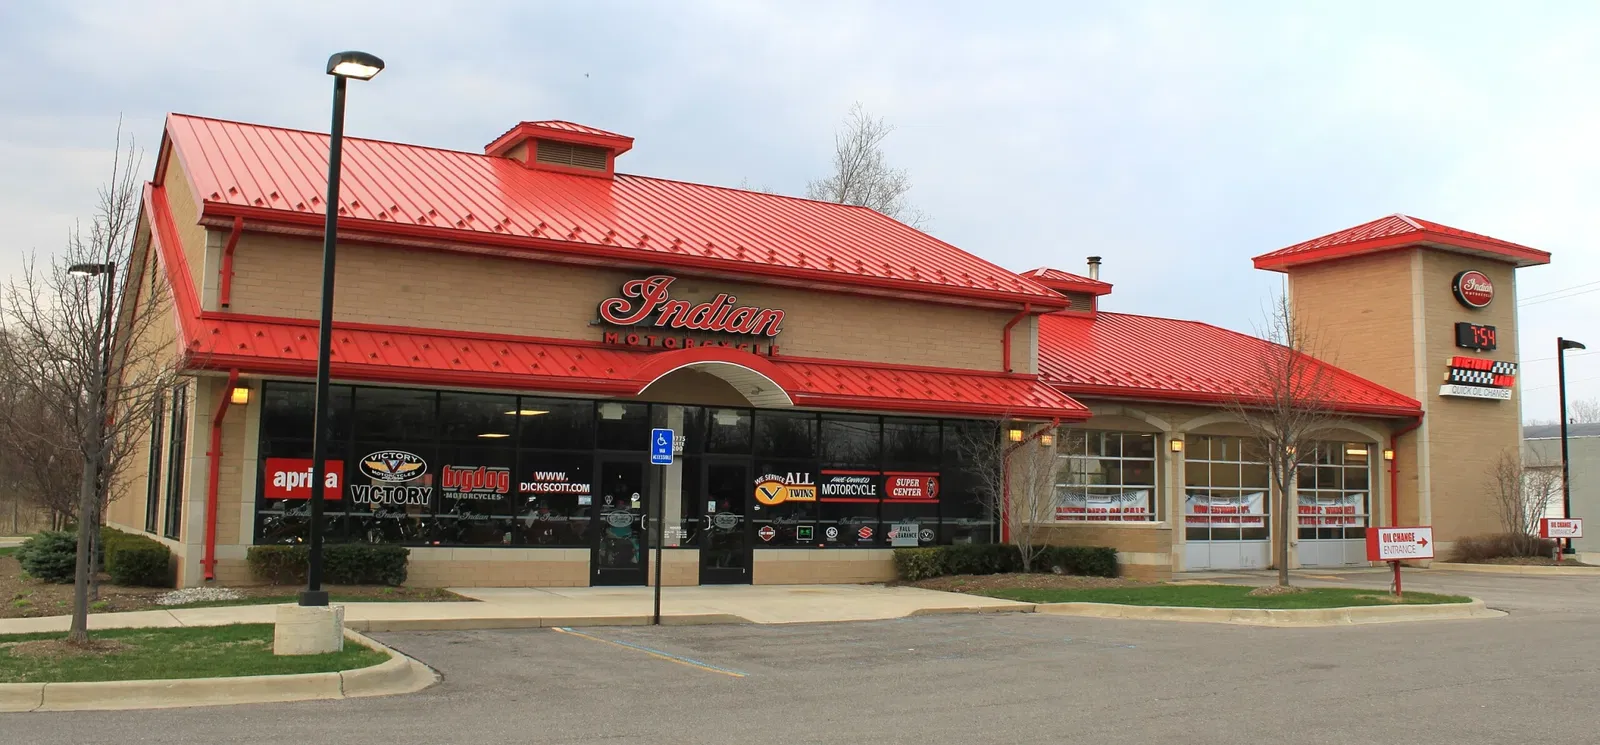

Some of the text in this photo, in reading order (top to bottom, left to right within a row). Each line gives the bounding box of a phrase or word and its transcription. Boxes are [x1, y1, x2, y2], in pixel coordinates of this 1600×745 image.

[600, 275, 785, 337] Indian
[1471, 326, 1495, 346] 7:54
[1452, 356, 1494, 370] VICTORY
[1452, 385, 1472, 397] QUICK
[1483, 388, 1509, 399] CHANGE
[371, 452, 418, 463] VICTORY
[273, 467, 337, 491] apria
[534, 471, 569, 481] WWW.
[764, 473, 786, 484] SERVICE
[784, 471, 815, 485] ALL
[519, 482, 591, 493] DICKSCOTT.COM
[895, 478, 920, 487] SUPER
[350, 484, 433, 505] VICTORY
[788, 489, 814, 498] TWINS
[821, 483, 876, 496] MOTORCYCLE
[893, 487, 922, 497] CENTER
[1383, 532, 1416, 543] OIL CHANGE
[1383, 544, 1416, 555] ENTRANCE
